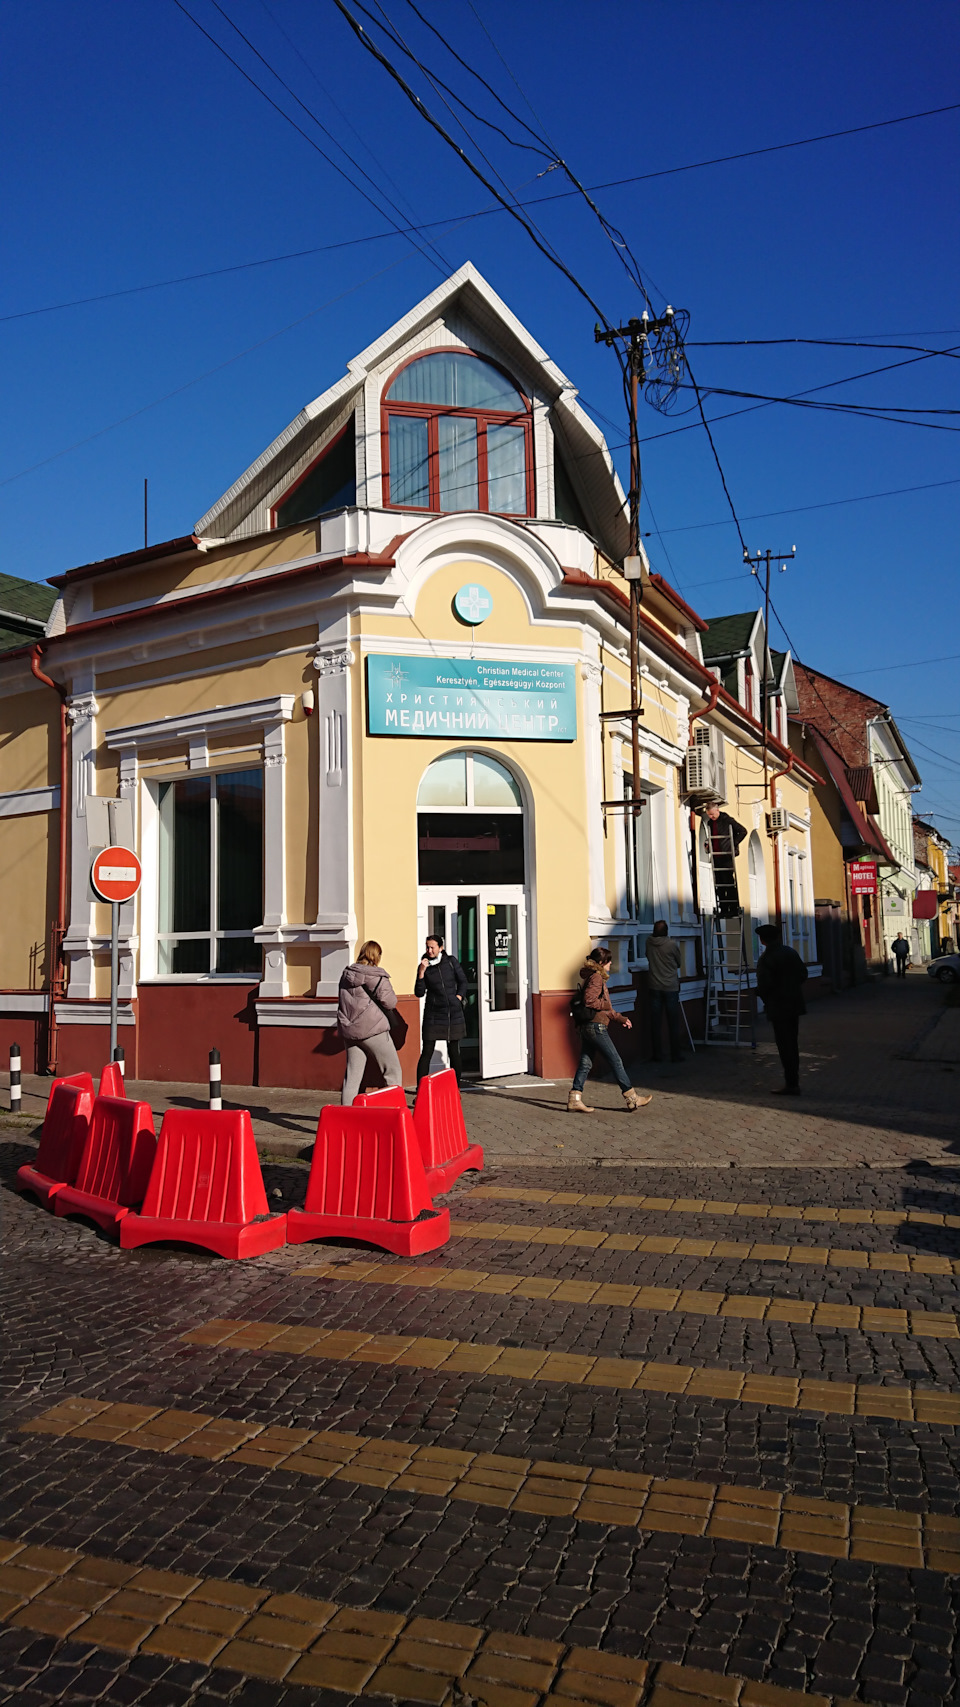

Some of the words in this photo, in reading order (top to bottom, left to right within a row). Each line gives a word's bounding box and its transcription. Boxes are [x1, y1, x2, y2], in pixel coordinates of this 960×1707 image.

[477, 666, 510, 676] Christian
[511, 667, 539, 677] Medical
[540, 669, 564, 678] Center
[483, 678, 534, 690] Egészségügyi
[386, 693, 558, 710] ХРИСТИЯНСЬКИЙ
[385, 709, 489, 730] МЕДИЧНИЙ
[498, 713, 559, 735] ЦЕНТР
[853, 872, 875, 880] HOTEL
